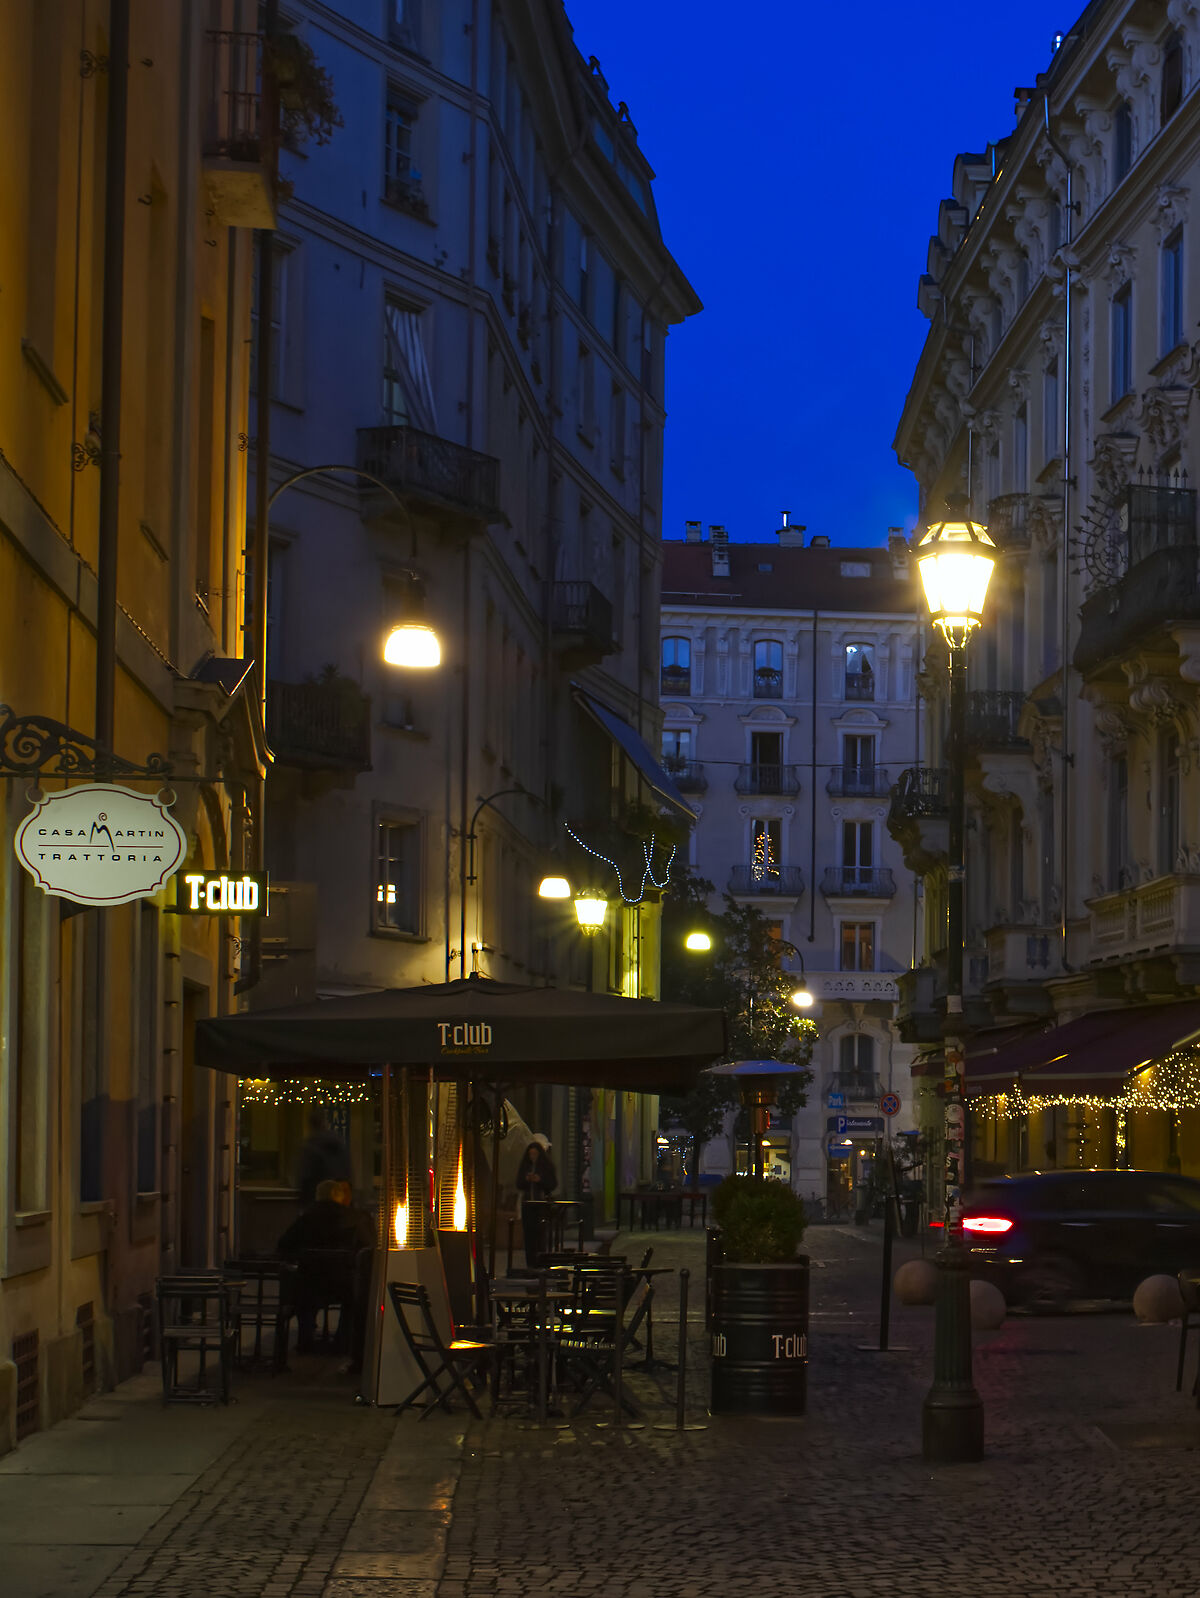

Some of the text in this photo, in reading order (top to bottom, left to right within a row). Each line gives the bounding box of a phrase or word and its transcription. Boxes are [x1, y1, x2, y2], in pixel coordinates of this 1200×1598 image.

[38, 821, 164, 852] CASA MARTIN
[38, 853, 162, 862] TRATTORIA
